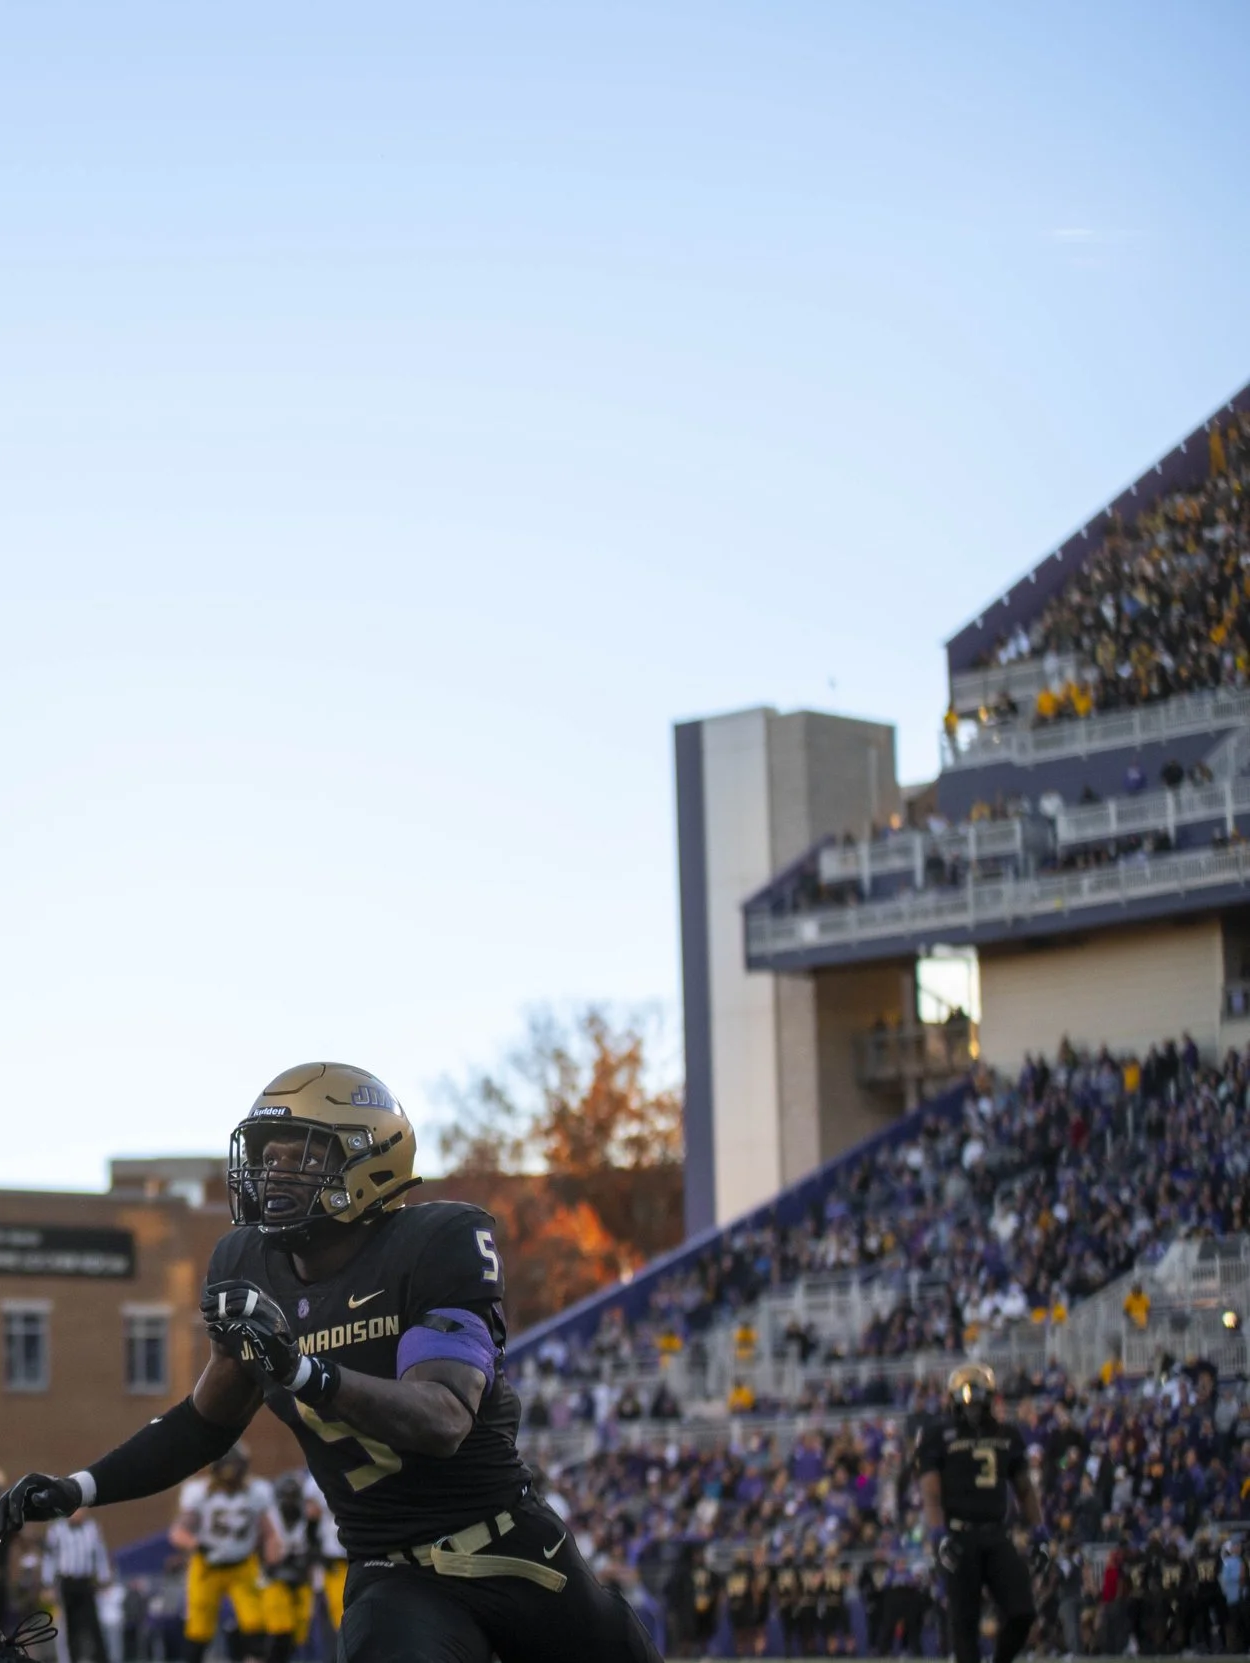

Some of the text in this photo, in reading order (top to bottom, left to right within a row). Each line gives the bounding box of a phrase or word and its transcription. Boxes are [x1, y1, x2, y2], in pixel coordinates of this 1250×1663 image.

[474, 1228, 500, 1283] 5
[299, 1315, 400, 1356] MADISON
[971, 1448, 998, 1490] 3
